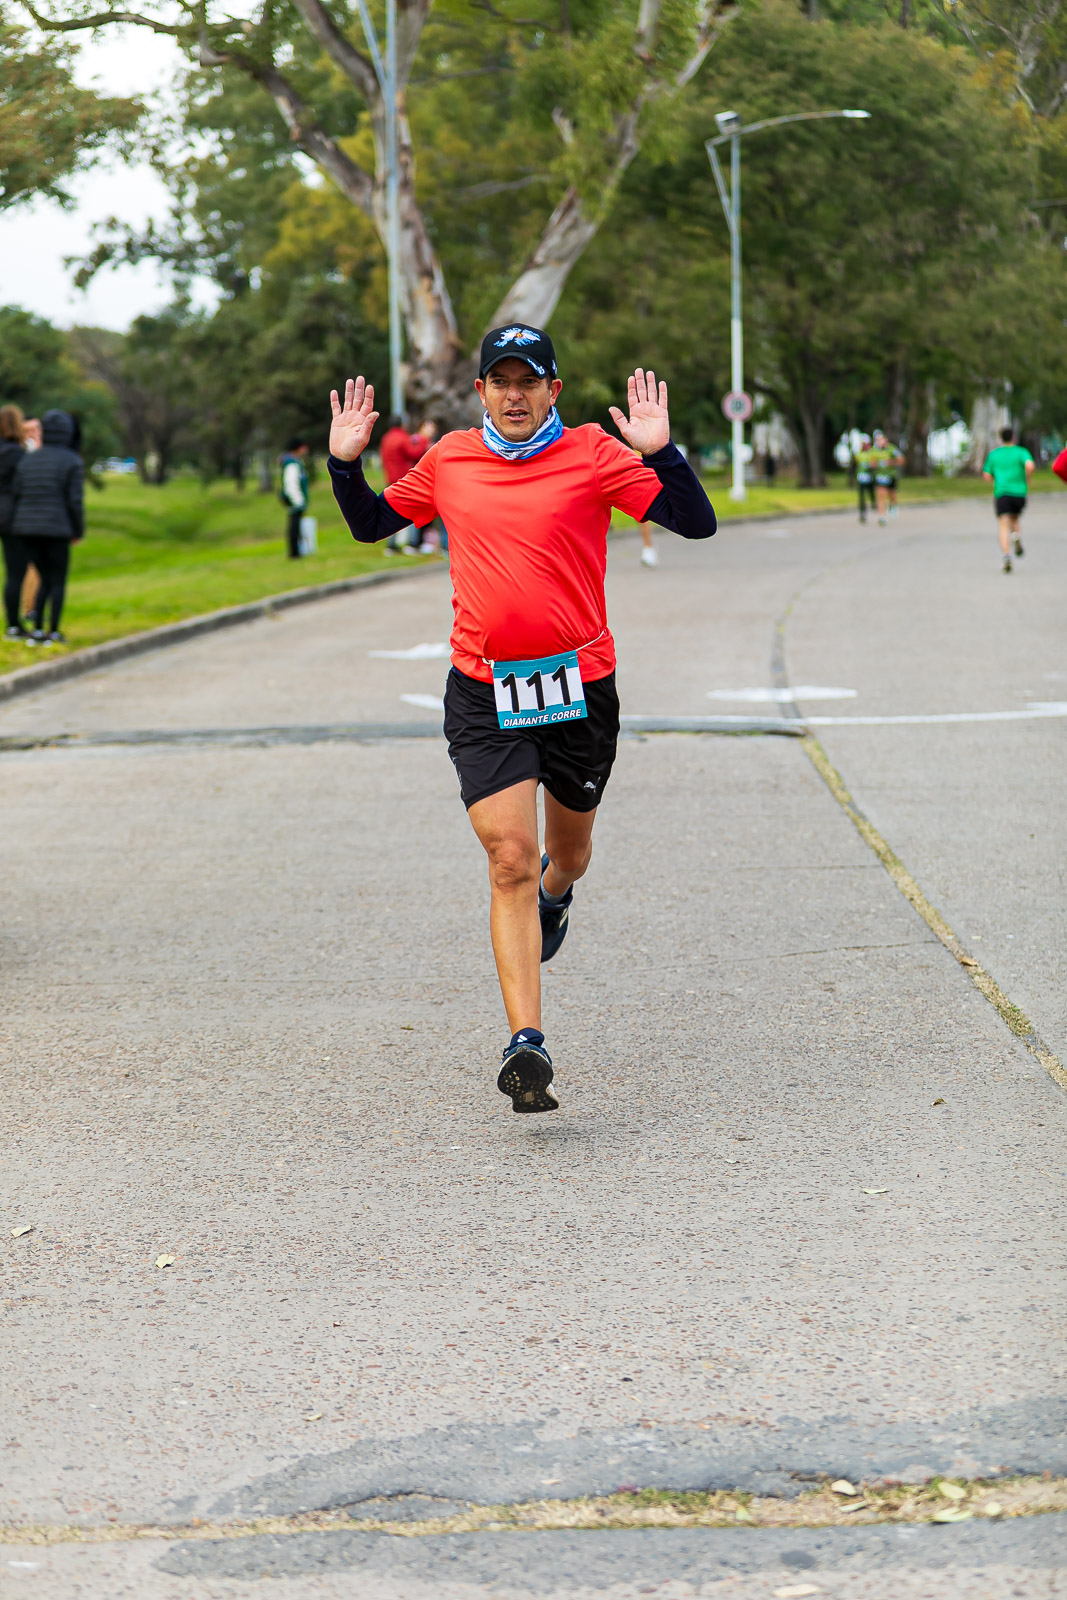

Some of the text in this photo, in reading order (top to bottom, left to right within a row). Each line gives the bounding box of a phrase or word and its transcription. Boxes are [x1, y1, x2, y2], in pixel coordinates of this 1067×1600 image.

[501, 664, 572, 714] 111
[503, 708, 582, 727] DIAMANTE CORRE
